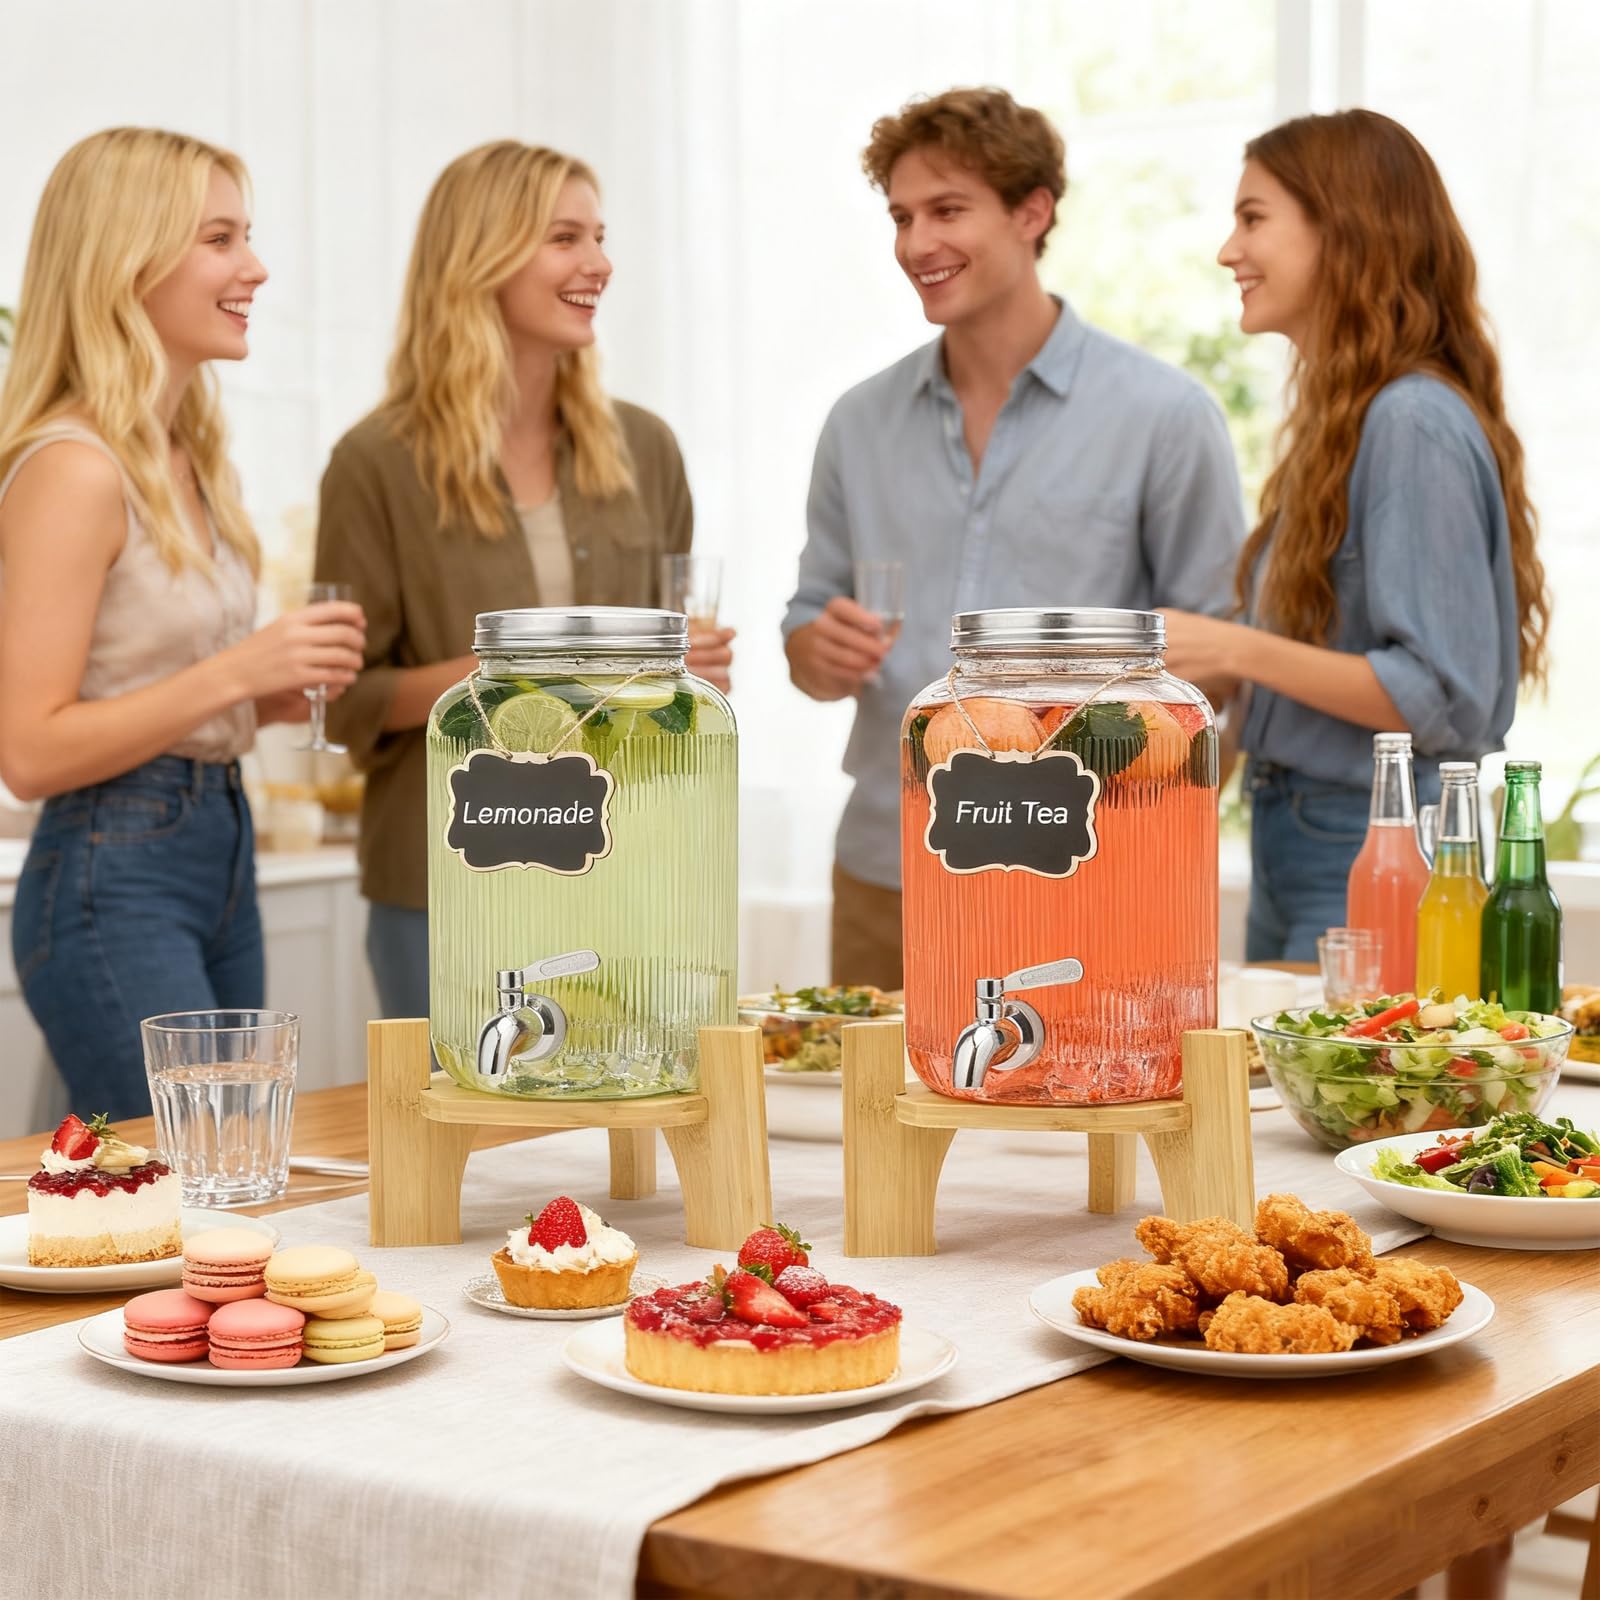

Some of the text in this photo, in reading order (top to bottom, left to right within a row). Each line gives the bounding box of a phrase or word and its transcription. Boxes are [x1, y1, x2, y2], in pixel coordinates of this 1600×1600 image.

[463, 800, 594, 825] Lemonade
[955, 800, 1068, 825] Fruit Tea
